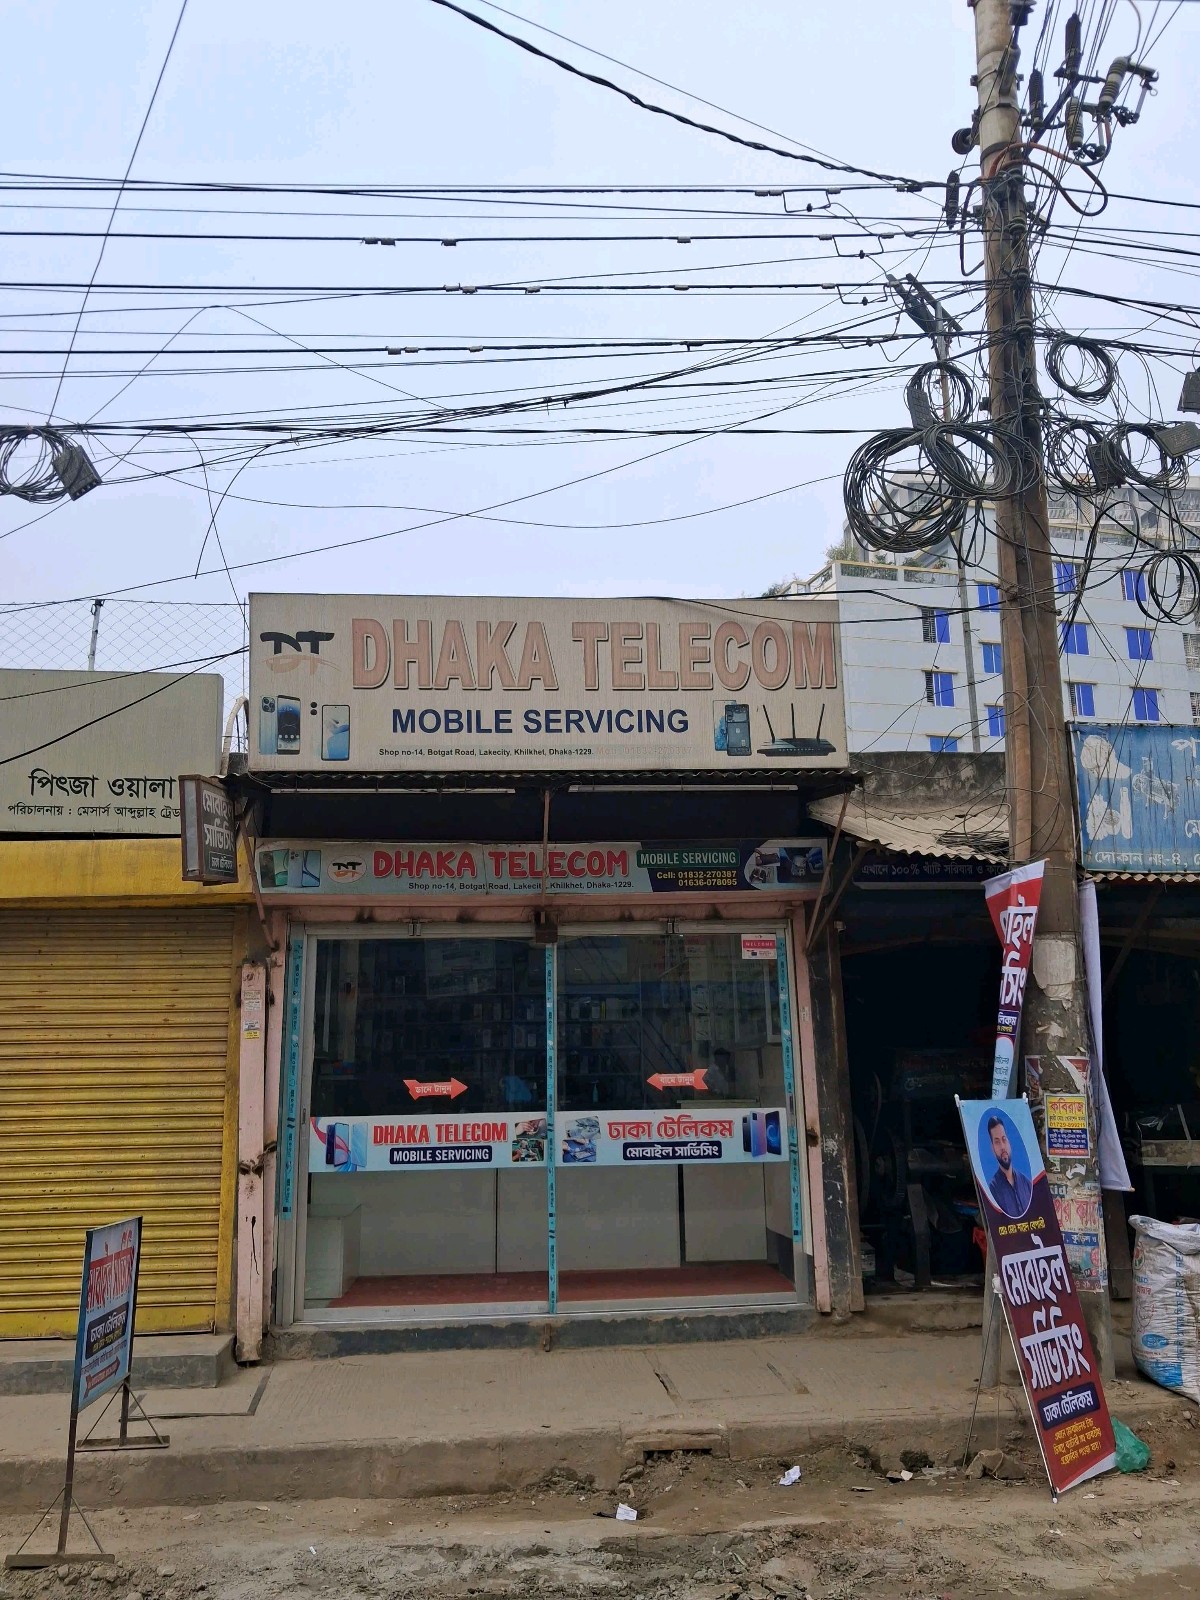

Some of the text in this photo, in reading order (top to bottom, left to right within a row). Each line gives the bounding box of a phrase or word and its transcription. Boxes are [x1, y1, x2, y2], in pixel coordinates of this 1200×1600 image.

[351, 618, 838, 692] DHAKA TELECOM
[392, 708, 690, 734] MOBILE SERVICING
[378, 748, 400, 757] Shop
[427, 748, 453, 758] Botgat
[454, 748, 477, 757] Road,
[548, 747, 594, 756] Dhaka-1229.
[28, 768, 177, 799] পিৎজা ওয়ালা
[7, 801, 64, 816] পরিচালনায়
[77, 802, 111, 817] মেসার্স
[373, 849, 630, 878] DHAKA TELECOM
[640, 850, 737, 866] MOBILE SERVICING
[1095, 851, 1143, 865] দোকান
[656, 870, 737, 879] Cell: 01832-270387
[861, 863, 889, 875] এখানে
[408, 882, 430, 891] Shop
[459, 882, 486, 891] Botgat
[586, 881, 634, 890] Dhaka-1229.
[678, 878, 738, 887] 01636-078095
[1049, 1097, 1085, 1115] কবিরাজ
[373, 1122, 508, 1145] DHAKA TELECOM
[607, 1114, 734, 1140] ঢাকা টেলিকম
[393, 1148, 489, 1163] MOBILE SERVICING
[626, 1142, 719, 1158] মোবাইল সার্ভিসিং
[1001, 1234, 1071, 1308] মোবাইল
[1019, 1305, 1091, 1393] সার্ভিসিং
[1043, 1390, 1094, 1422] ঢাকা টেলিকম
